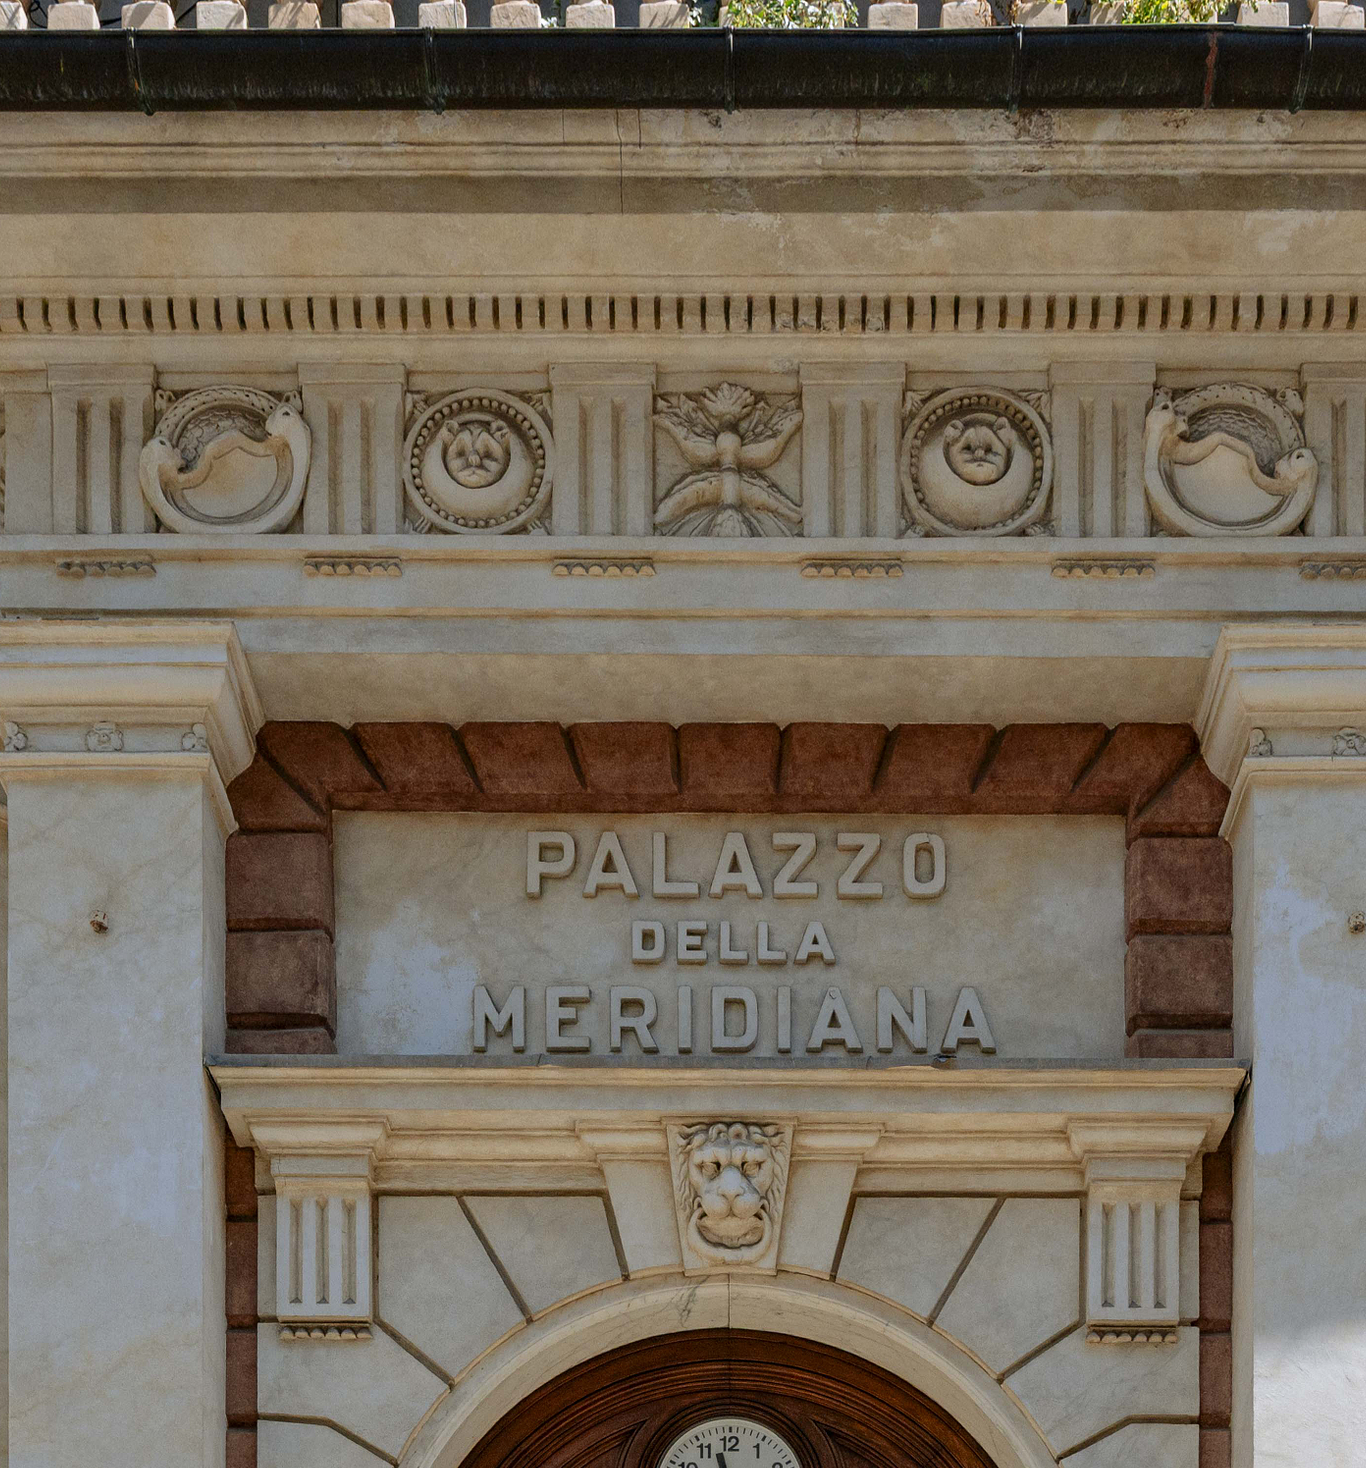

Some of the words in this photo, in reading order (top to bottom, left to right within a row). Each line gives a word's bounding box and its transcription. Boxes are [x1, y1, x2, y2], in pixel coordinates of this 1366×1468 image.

[526, 831, 947, 899] PALAZZO
[632, 920, 836, 965] DELLA
[472, 985, 998, 1054] MERIDIANA
[696, 1443, 712, 1459] 11
[719, 1436, 740, 1452] 12
[753, 1443, 760, 1459] 1
